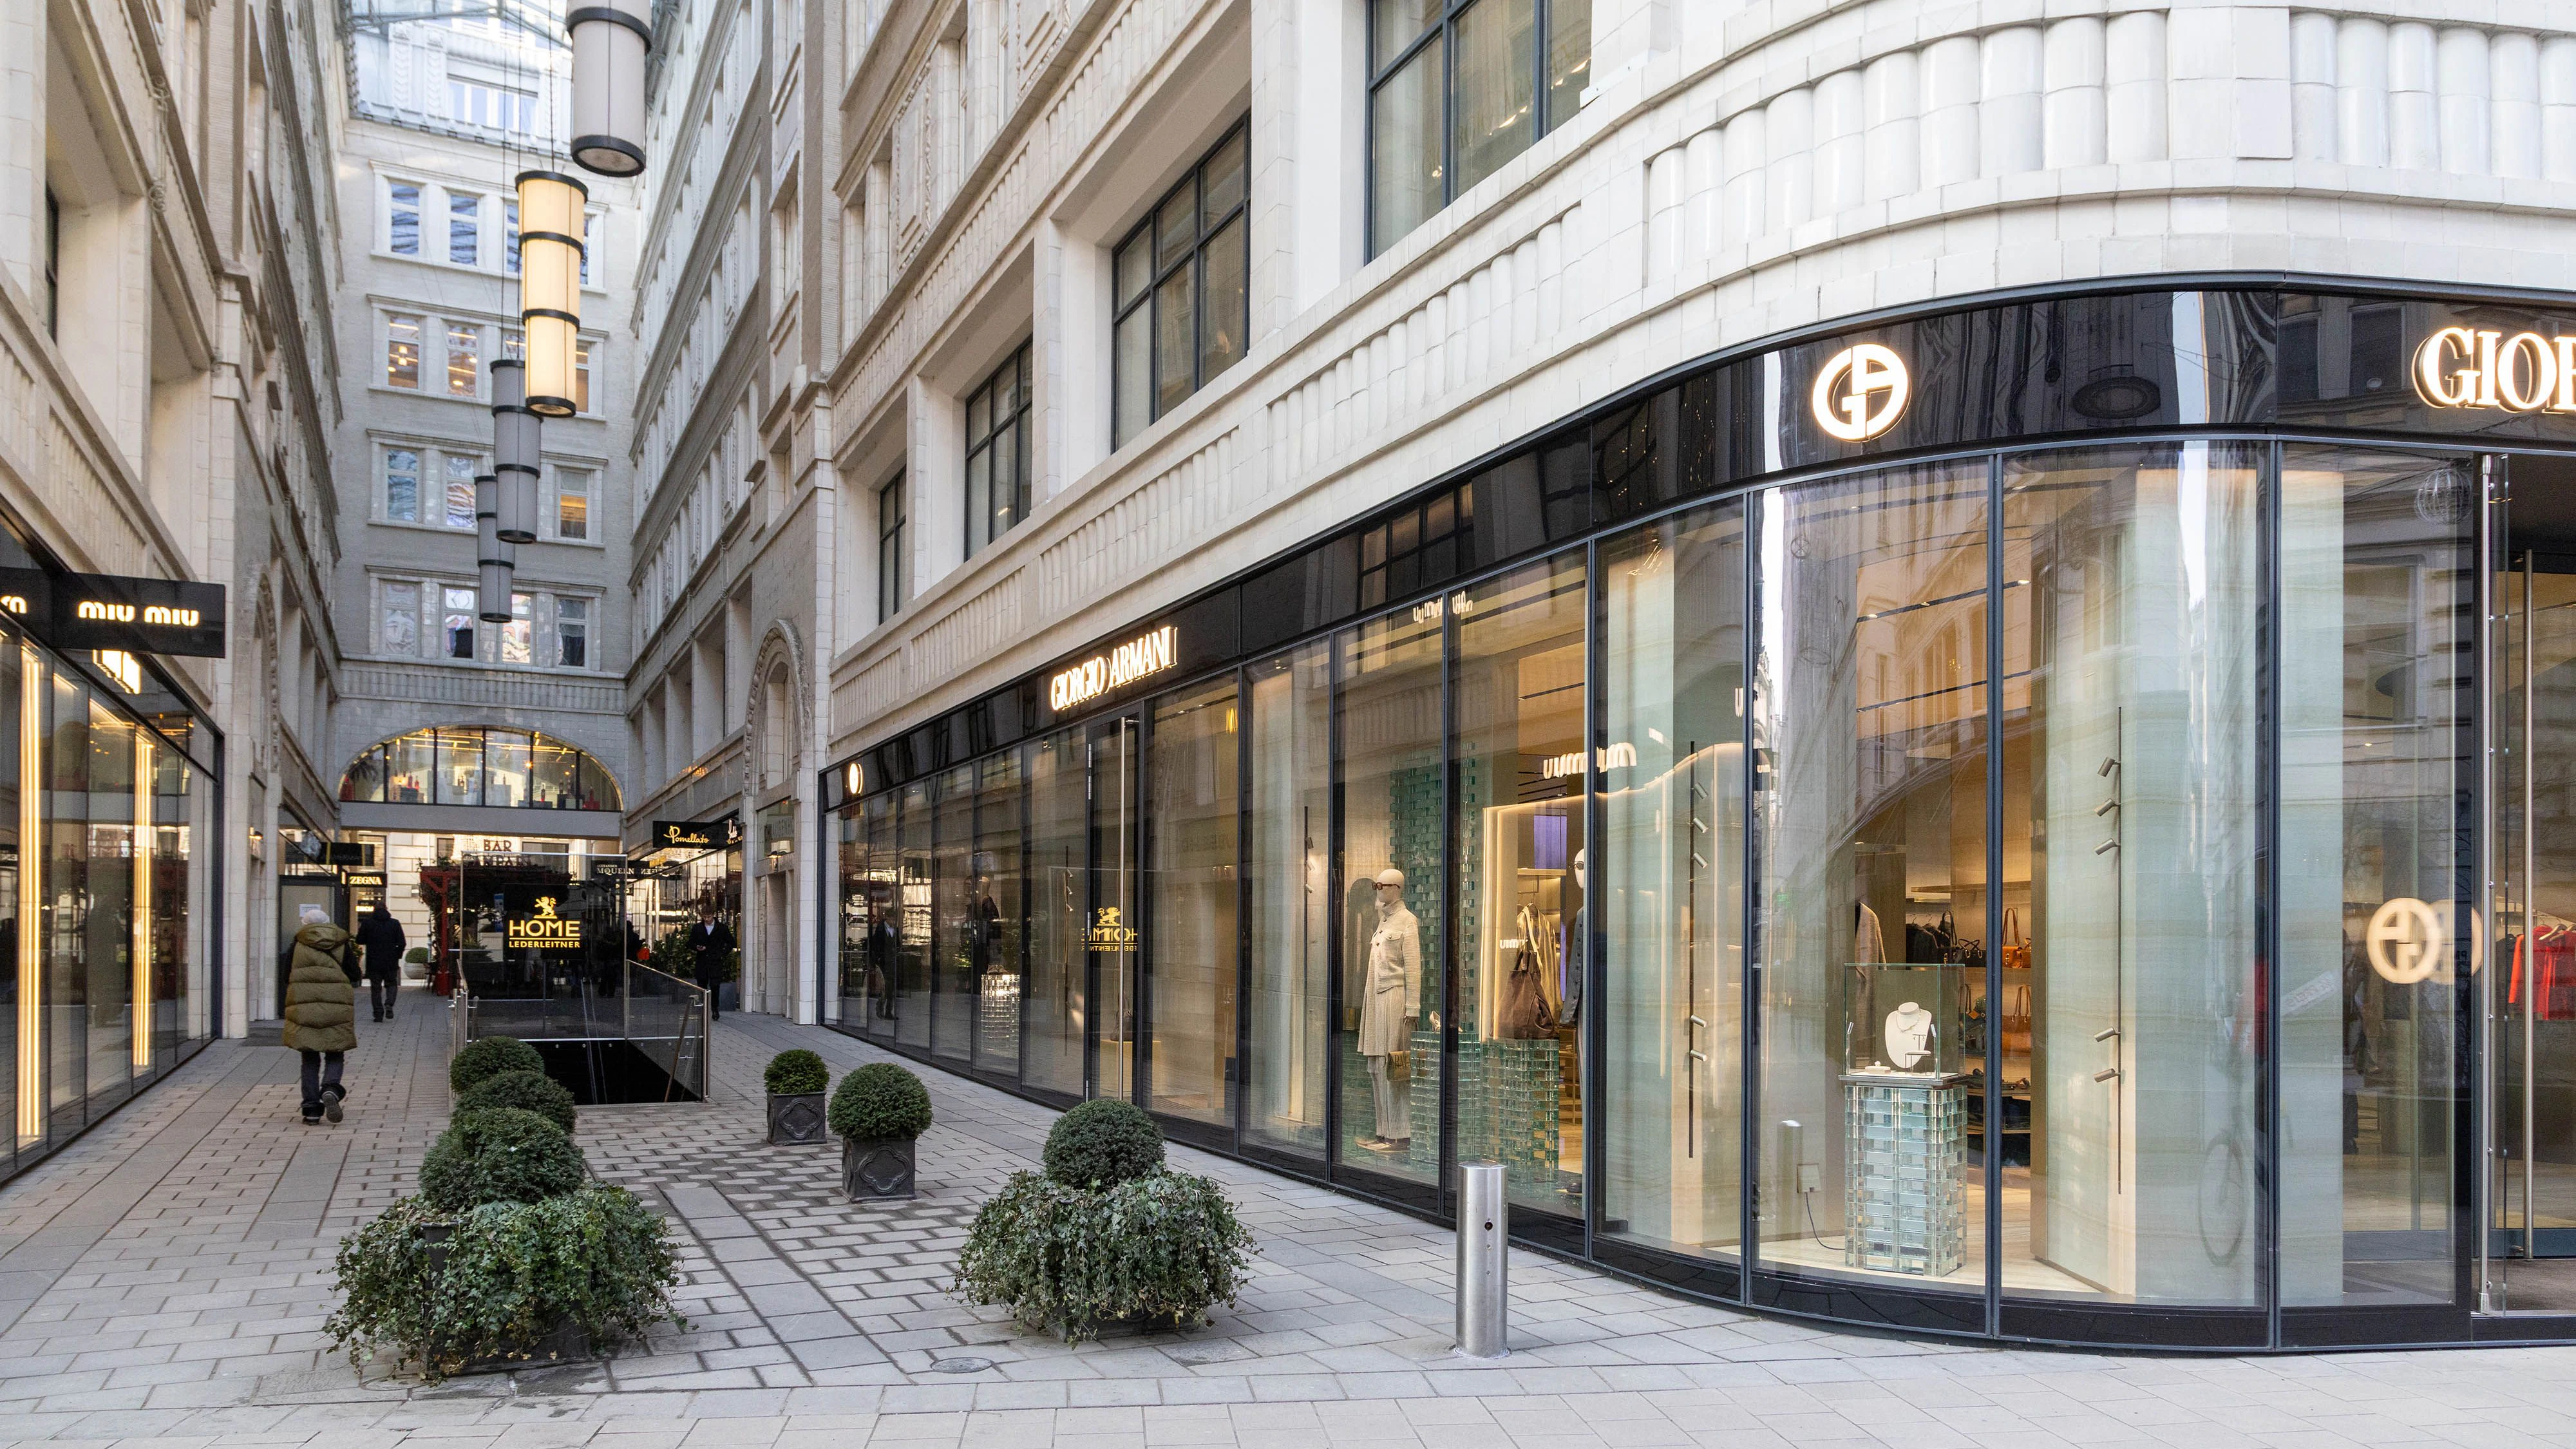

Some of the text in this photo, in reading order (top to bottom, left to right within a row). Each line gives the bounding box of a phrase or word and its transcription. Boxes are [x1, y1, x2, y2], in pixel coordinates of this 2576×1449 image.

[1051, 626, 1173, 710] GIORGIO ARMANI
[663, 826, 709, 844] Pomellato
[484, 839, 512, 852] BAR
[350, 876, 383, 886] ZEGNA
[509, 920, 580, 936] HOME
